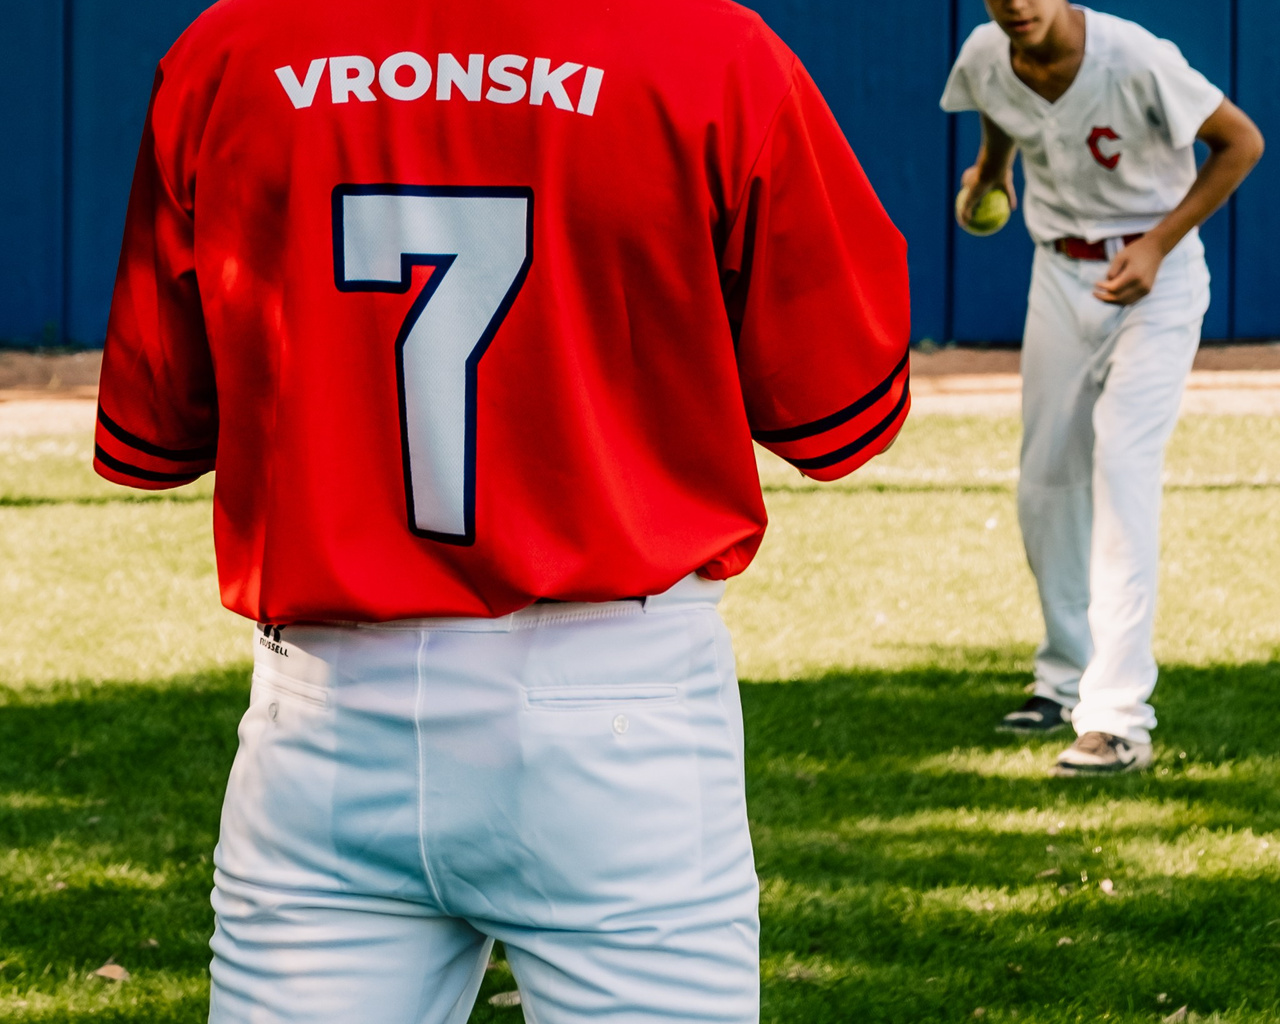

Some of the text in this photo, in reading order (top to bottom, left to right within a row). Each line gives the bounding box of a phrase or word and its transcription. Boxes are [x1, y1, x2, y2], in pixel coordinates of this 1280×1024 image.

[274, 51, 605, 117] VRONSKI
[1086, 126, 1121, 171] C
[331, 182, 535, 547] 7
[259, 637, 289, 658] RUSSELL
